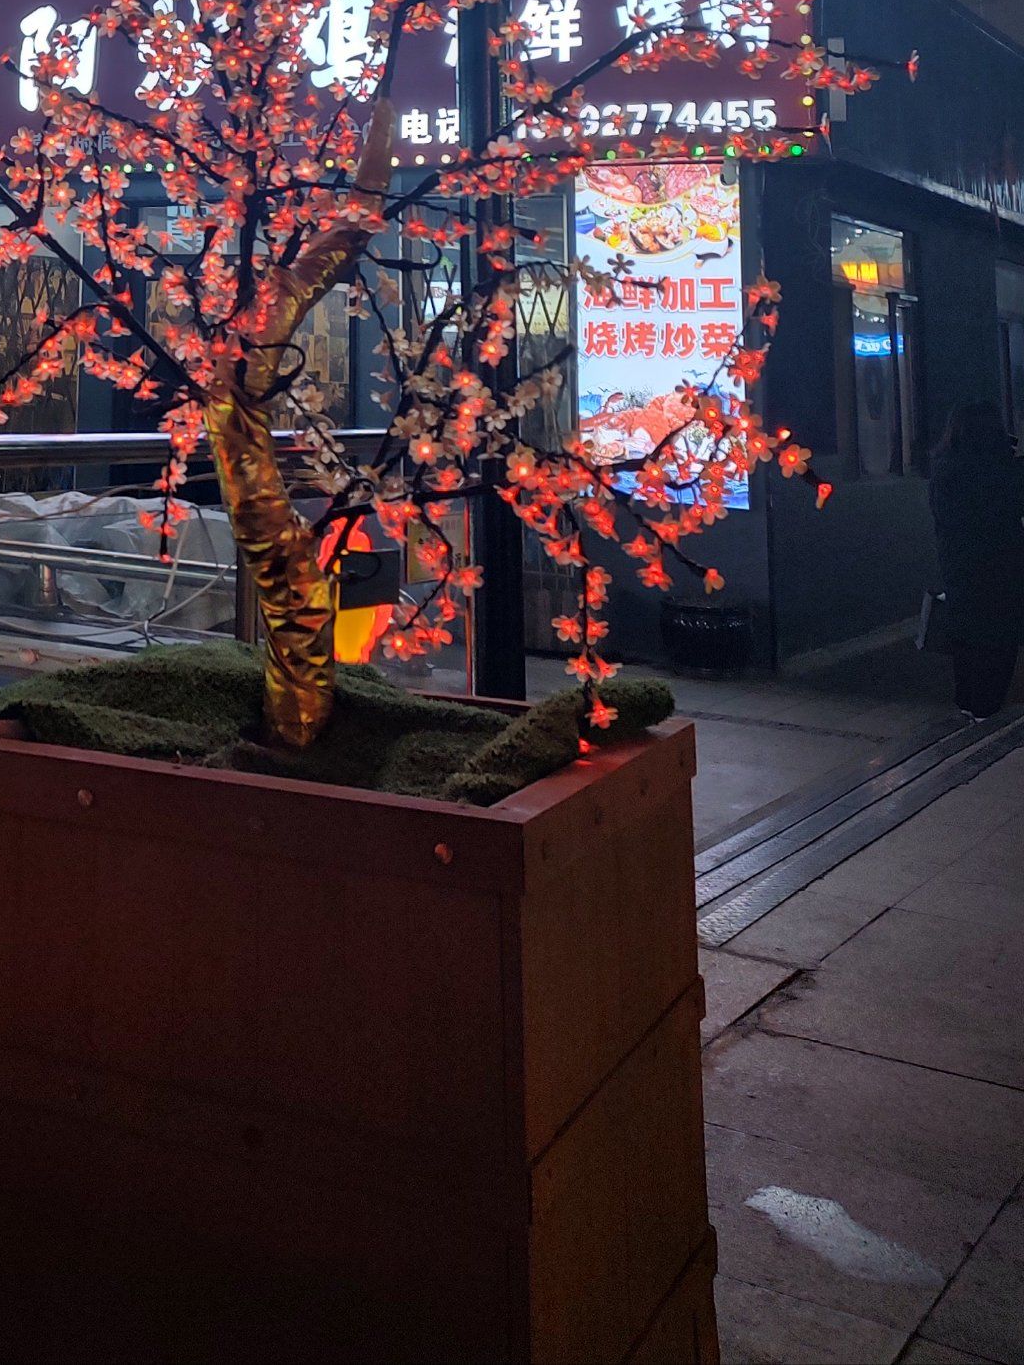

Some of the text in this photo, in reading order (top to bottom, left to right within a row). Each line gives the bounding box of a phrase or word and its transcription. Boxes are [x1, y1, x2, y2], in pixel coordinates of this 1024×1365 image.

[512, 98, 778, 139] 192774455
[583, 275, 737, 311] 海鲜加工
[583, 321, 738, 359] 烧烤炒菜
